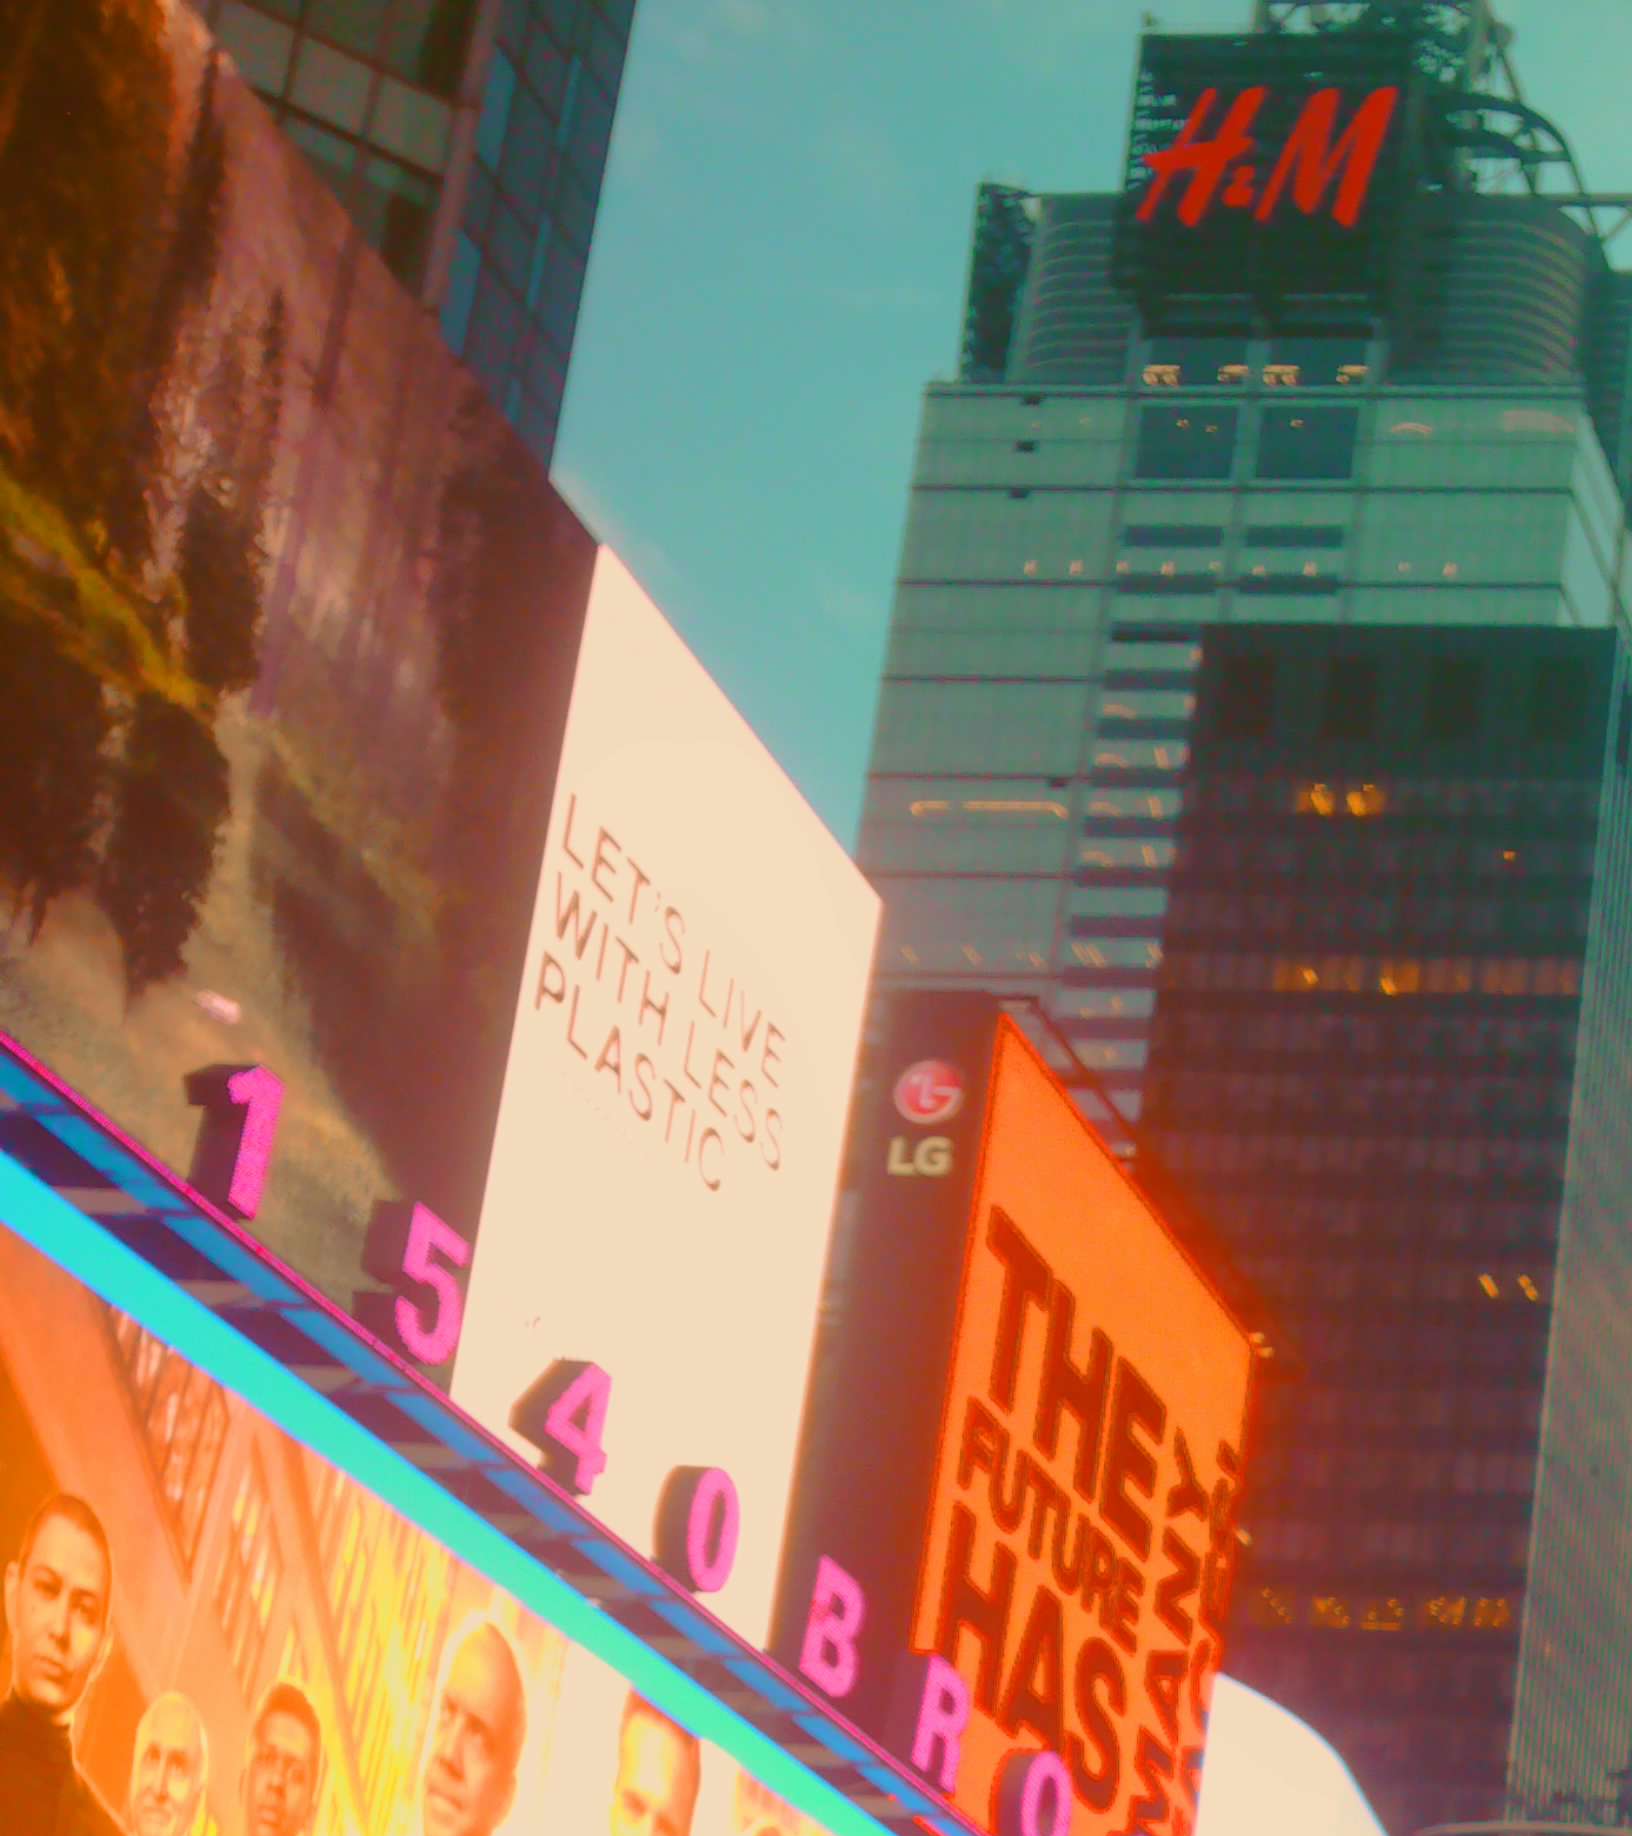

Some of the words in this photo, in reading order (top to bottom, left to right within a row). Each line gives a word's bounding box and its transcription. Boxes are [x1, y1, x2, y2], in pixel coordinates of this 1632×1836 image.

[1135, 85, 1399, 228] H&M
[536, 952, 723, 1191] PLASTIC
[556, 872, 669, 1045] WITH
[685, 1021, 783, 1171] LESS
[563, 794, 686, 975] LET'S
[699, 949, 785, 1087] LIVE
[887, 1137, 952, 1176] LG
[987, 1204, 1167, 1562] THE
[935, 1500, 1127, 1813] HAS
[957, 1396, 1145, 1656] FUTURE
